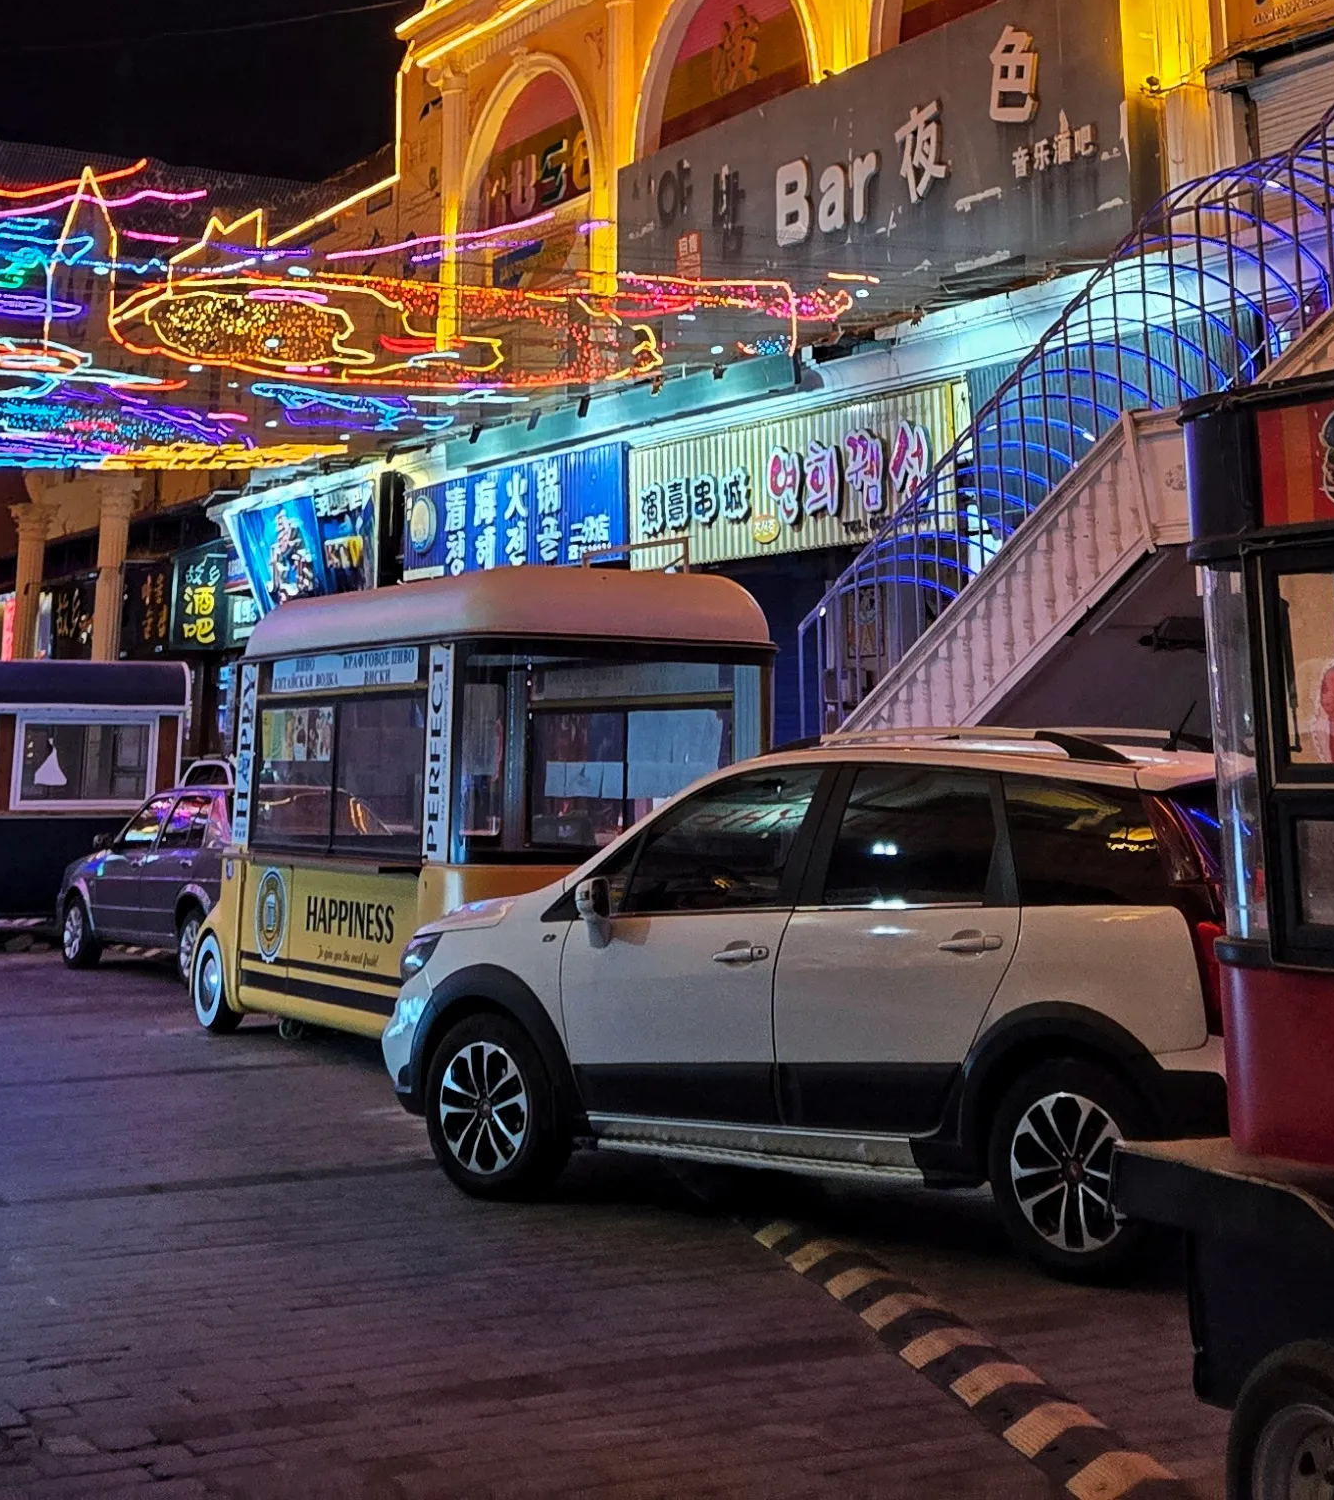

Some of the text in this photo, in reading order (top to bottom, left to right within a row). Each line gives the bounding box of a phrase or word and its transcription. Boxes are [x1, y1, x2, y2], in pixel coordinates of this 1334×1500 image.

[776, 150, 879, 248] Bar
[185, 564, 221, 587] 故乡
[183, 587, 216, 644] 酒吧
[426, 656, 447, 853] PERFECT
[306, 895, 395, 944] HAPPINESS
